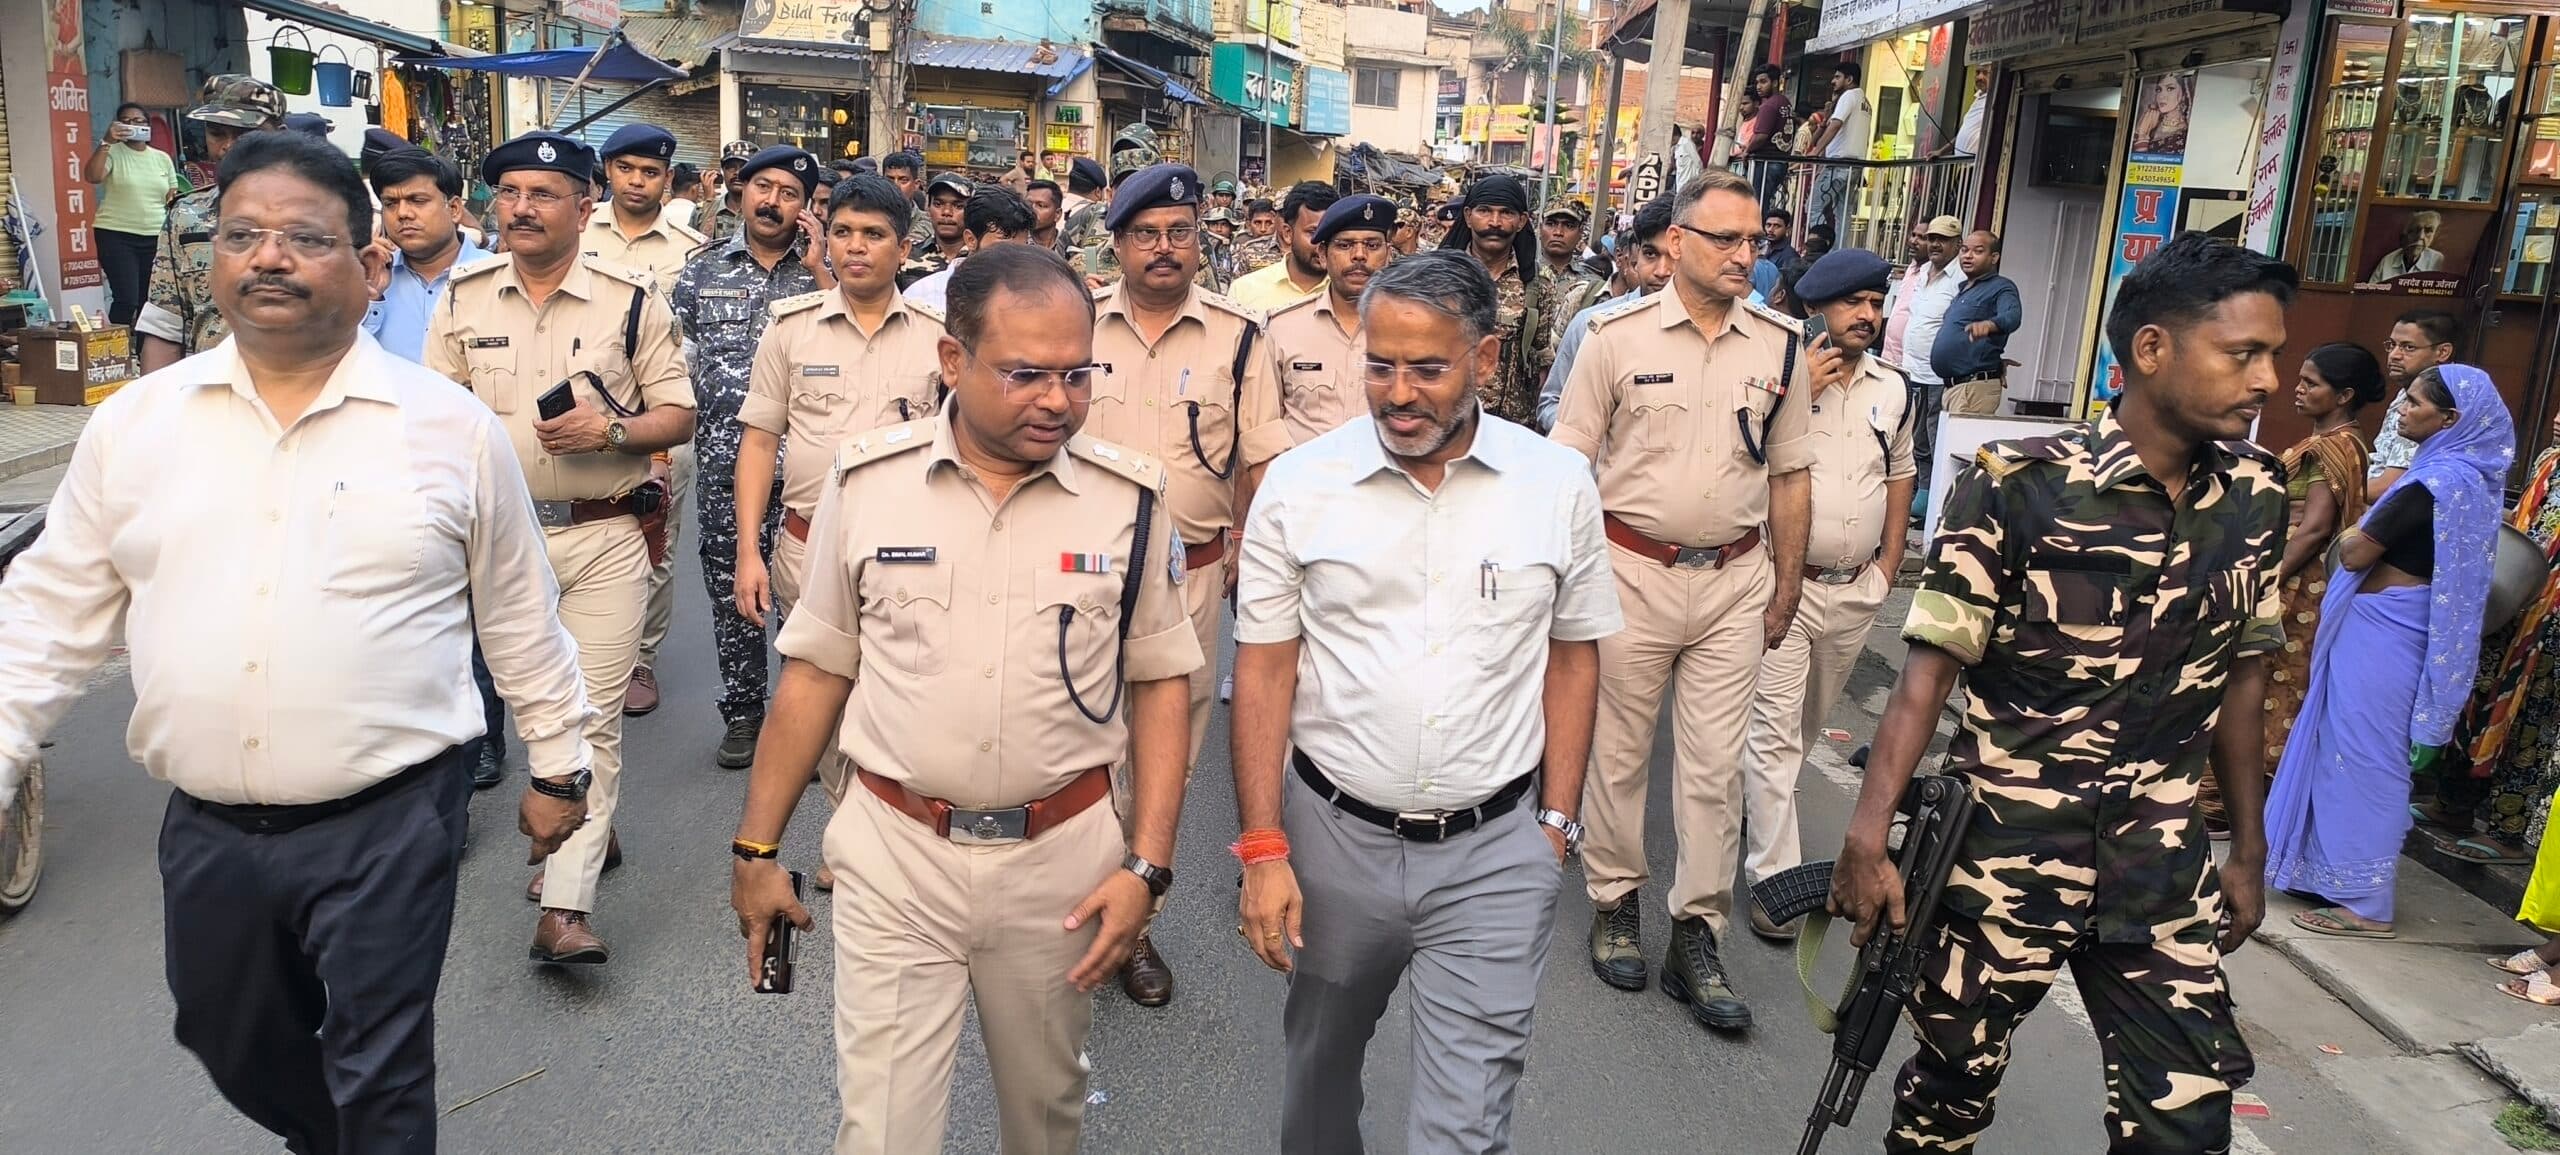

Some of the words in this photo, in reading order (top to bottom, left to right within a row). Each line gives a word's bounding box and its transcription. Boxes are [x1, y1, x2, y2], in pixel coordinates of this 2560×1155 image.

[776, 3, 813, 20] Bilal
[50, 79, 88, 112] अमित
[1633, 151, 1661, 211] JADU
[2258, 153, 2279, 185] राम
